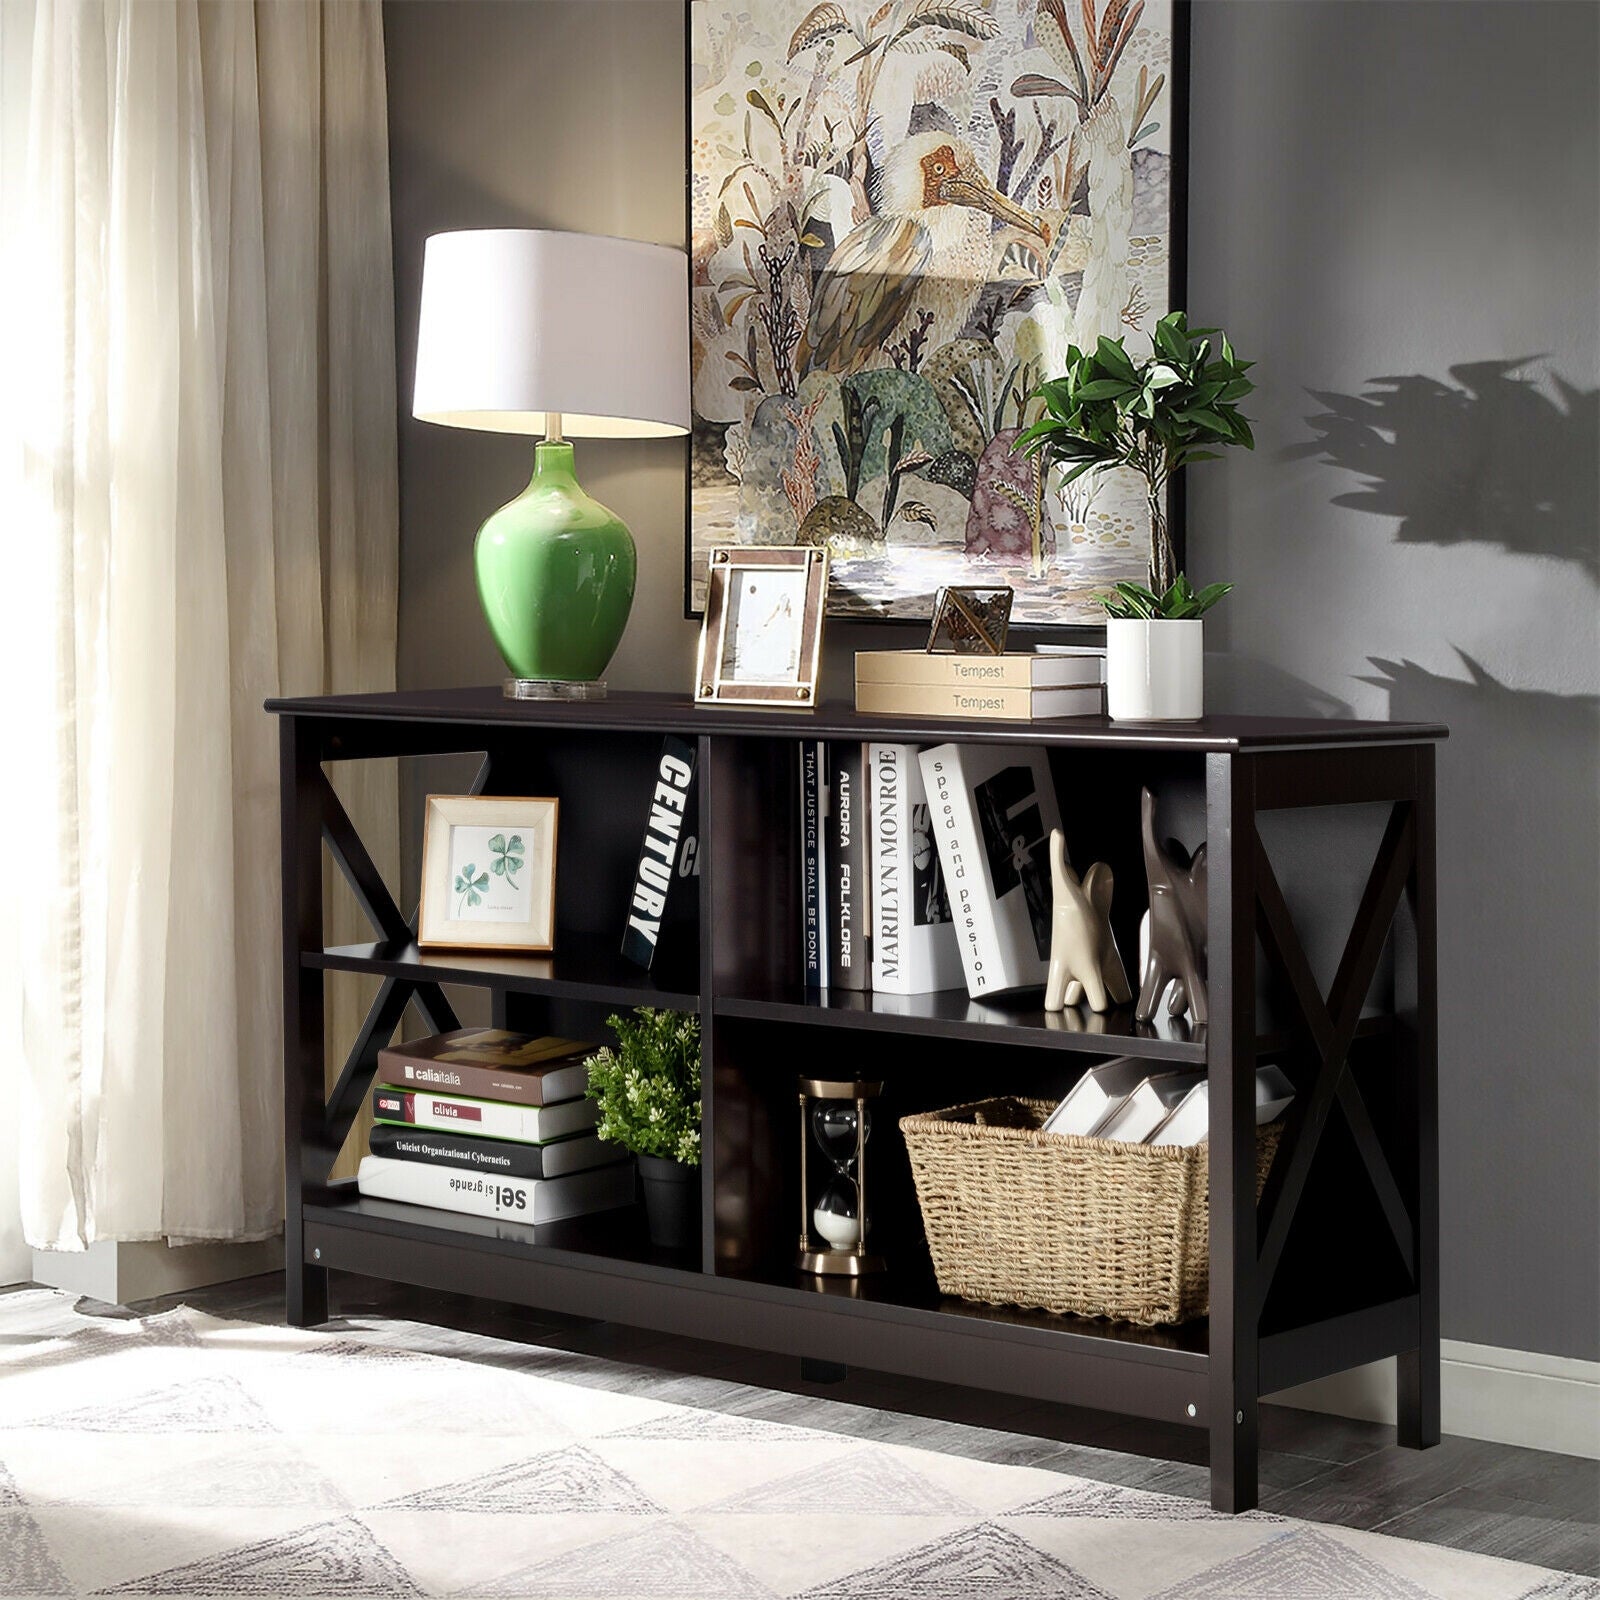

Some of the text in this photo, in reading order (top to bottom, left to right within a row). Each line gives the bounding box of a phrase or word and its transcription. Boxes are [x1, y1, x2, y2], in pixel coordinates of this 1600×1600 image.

[953, 663, 1004, 679] Tempest
[953, 694, 1004, 710] Tempest
[629, 754, 692, 947] CENTURY
[806, 751, 817, 969] THAT JUSTICE SHALL BE DONE
[879, 751, 899, 979] MARILYN MONROE
[839, 771, 851, 967] AURORA FOLKLORE
[934, 761, 986, 986] speed and passion
[415, 1068, 461, 1085] caliaitalia
[434, 1103, 458, 1117] olivia
[396, 1140, 511, 1167] Unicist Organizational Cybernetics
[449, 1178, 527, 1211] sei si grande
